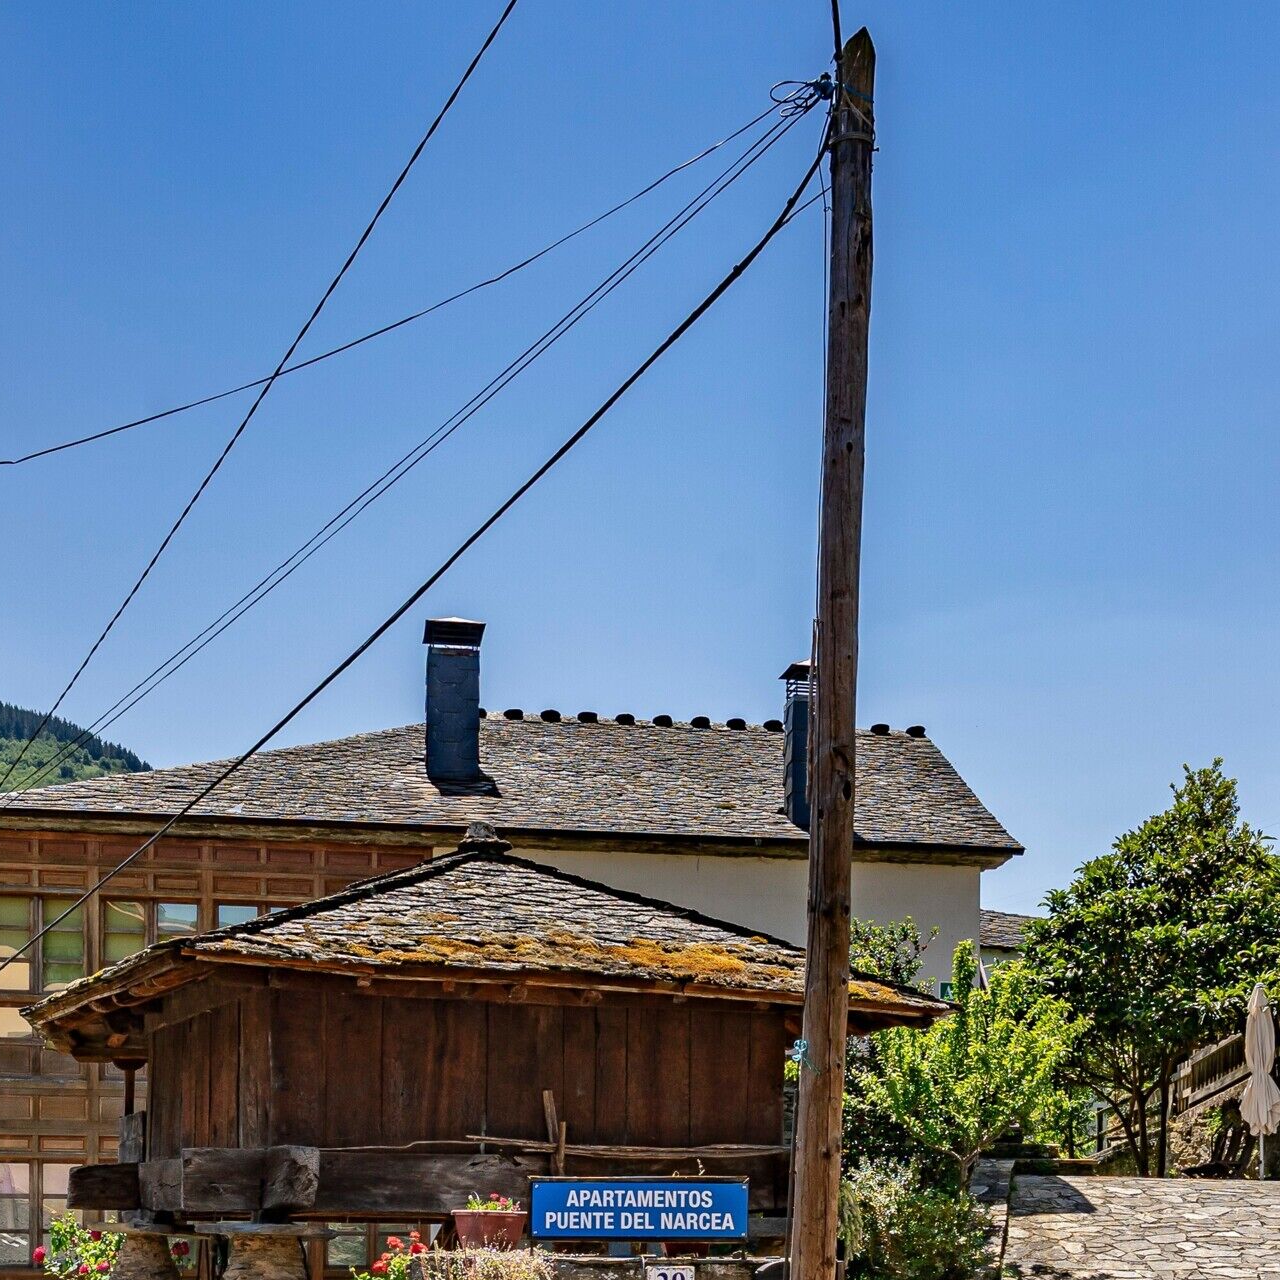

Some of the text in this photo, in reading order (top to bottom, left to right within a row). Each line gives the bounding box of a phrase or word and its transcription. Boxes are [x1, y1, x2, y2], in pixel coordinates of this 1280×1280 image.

[566, 1190, 713, 1208] APARTAMENTOS
[545, 1212, 735, 1231] PUENTE DEL NARCEA
